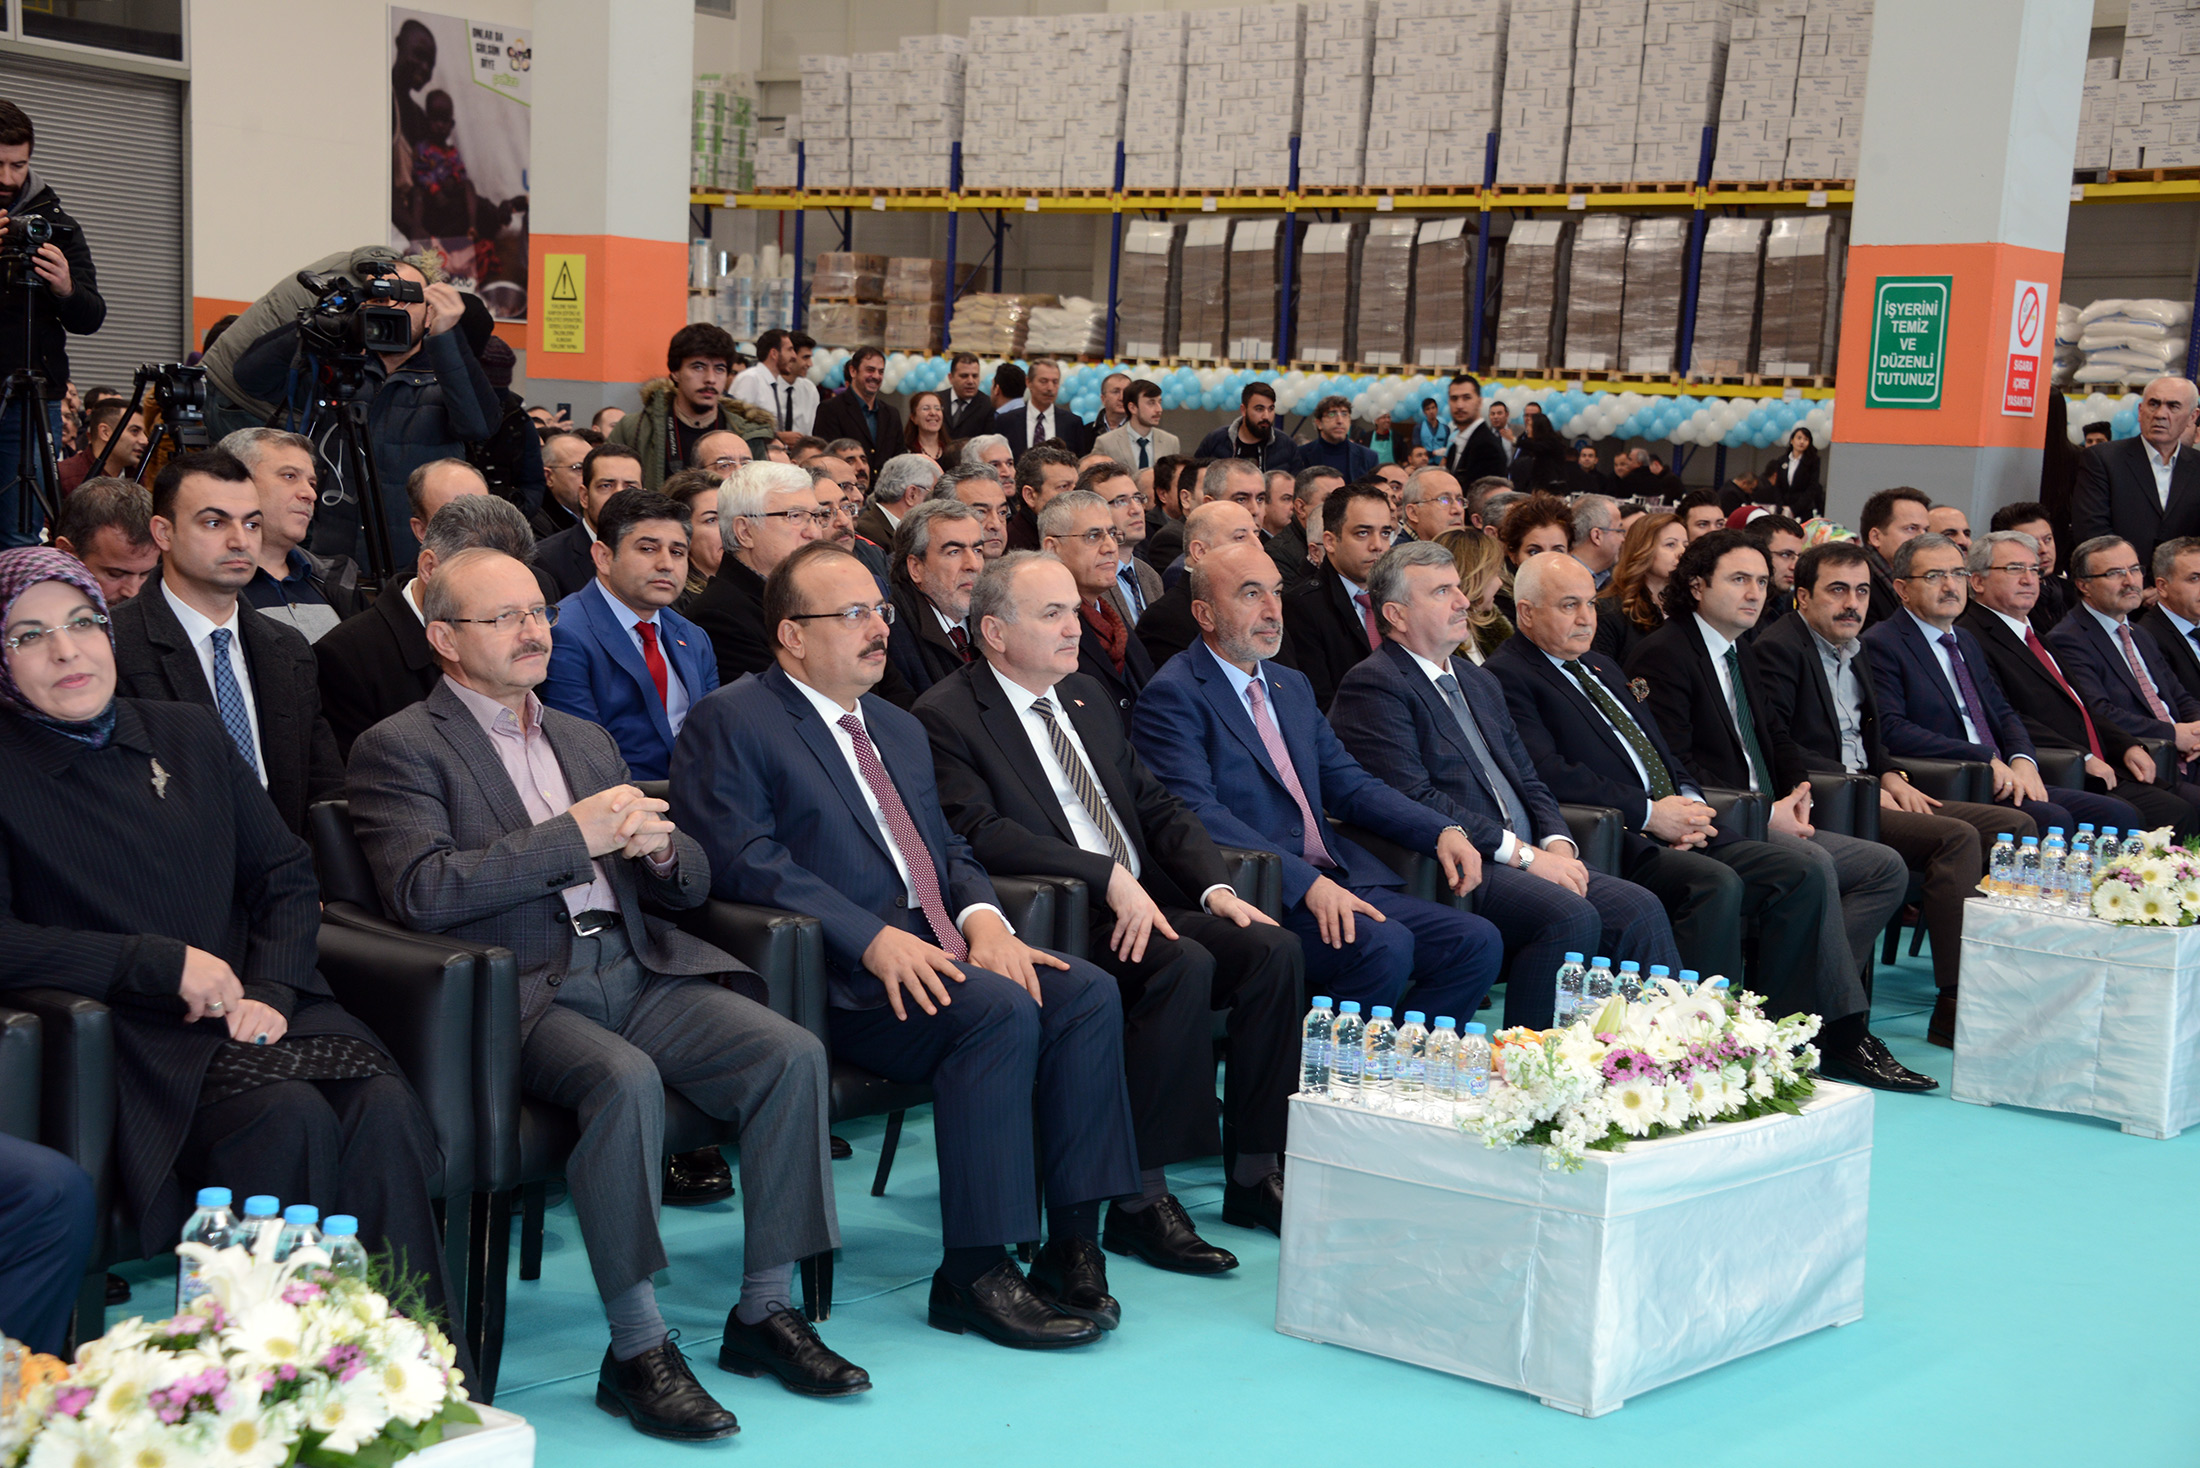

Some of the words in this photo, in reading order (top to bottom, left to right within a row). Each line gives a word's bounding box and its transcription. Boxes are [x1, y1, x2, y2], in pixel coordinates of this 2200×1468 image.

[1884, 300, 1938, 319] İŞYERİNİ
[1891, 317, 1929, 333] TEMİZ
[1899, 338, 1917, 351] VE
[1880, 352, 1934, 368] DÜZENLİ
[1876, 372, 1935, 386] TUTUNUZ
